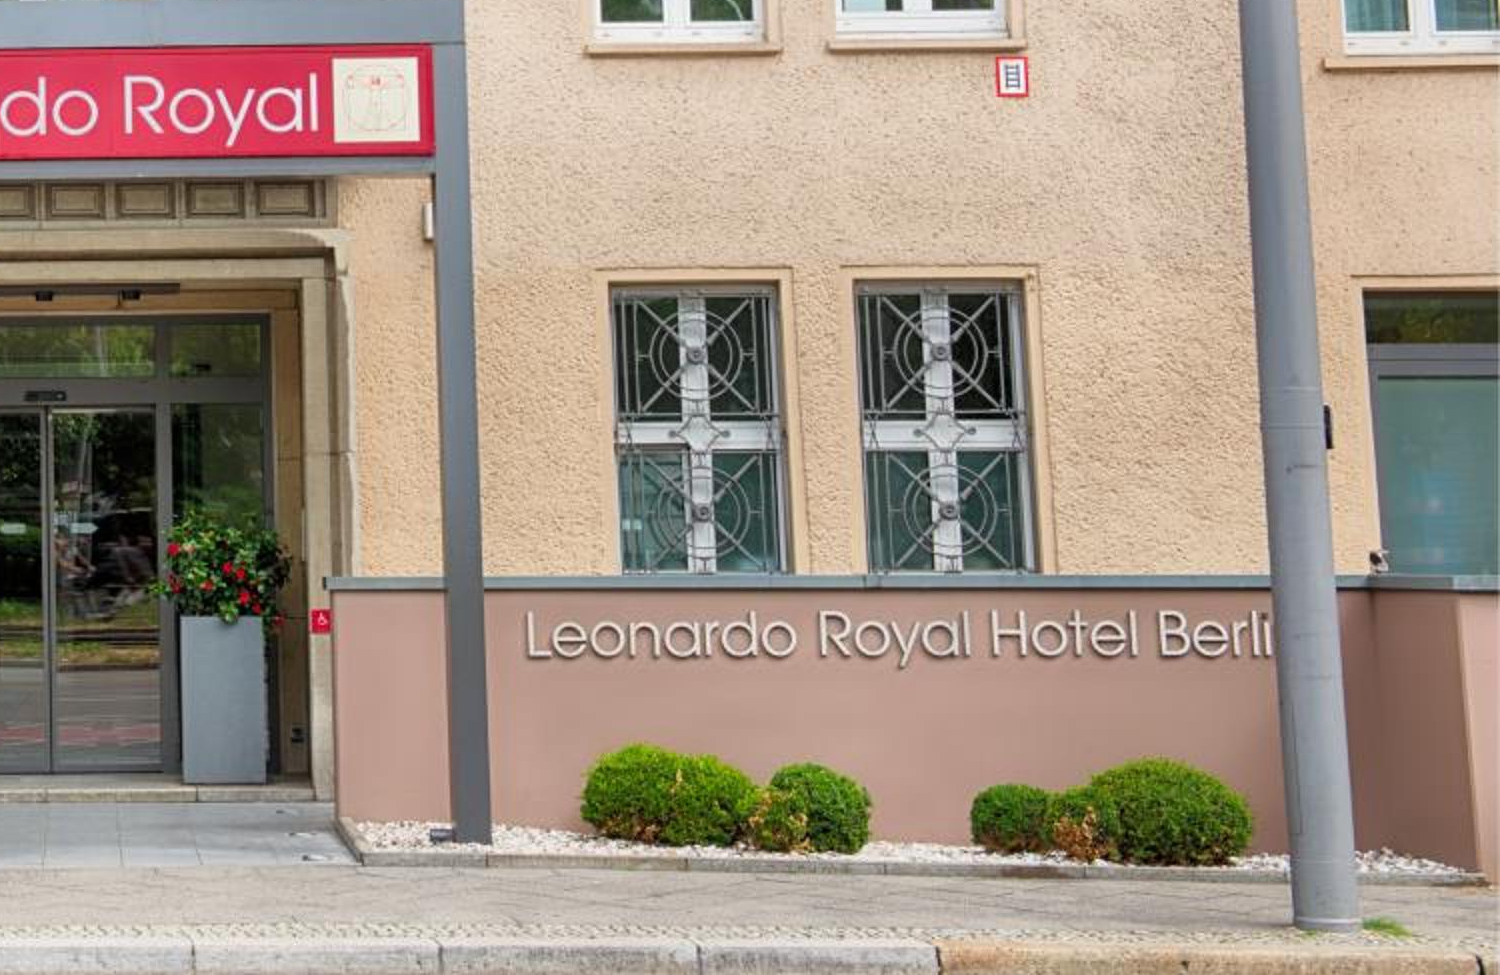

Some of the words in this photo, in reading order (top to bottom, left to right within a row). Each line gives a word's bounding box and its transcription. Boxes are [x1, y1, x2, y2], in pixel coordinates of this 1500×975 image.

[122, 72, 320, 148] Royal
[525, 610, 798, 658] Leonardo
[817, 609, 972, 669] Royal
[987, 608, 1140, 658] Hotel
[1157, 609, 1273, 658] Berli
